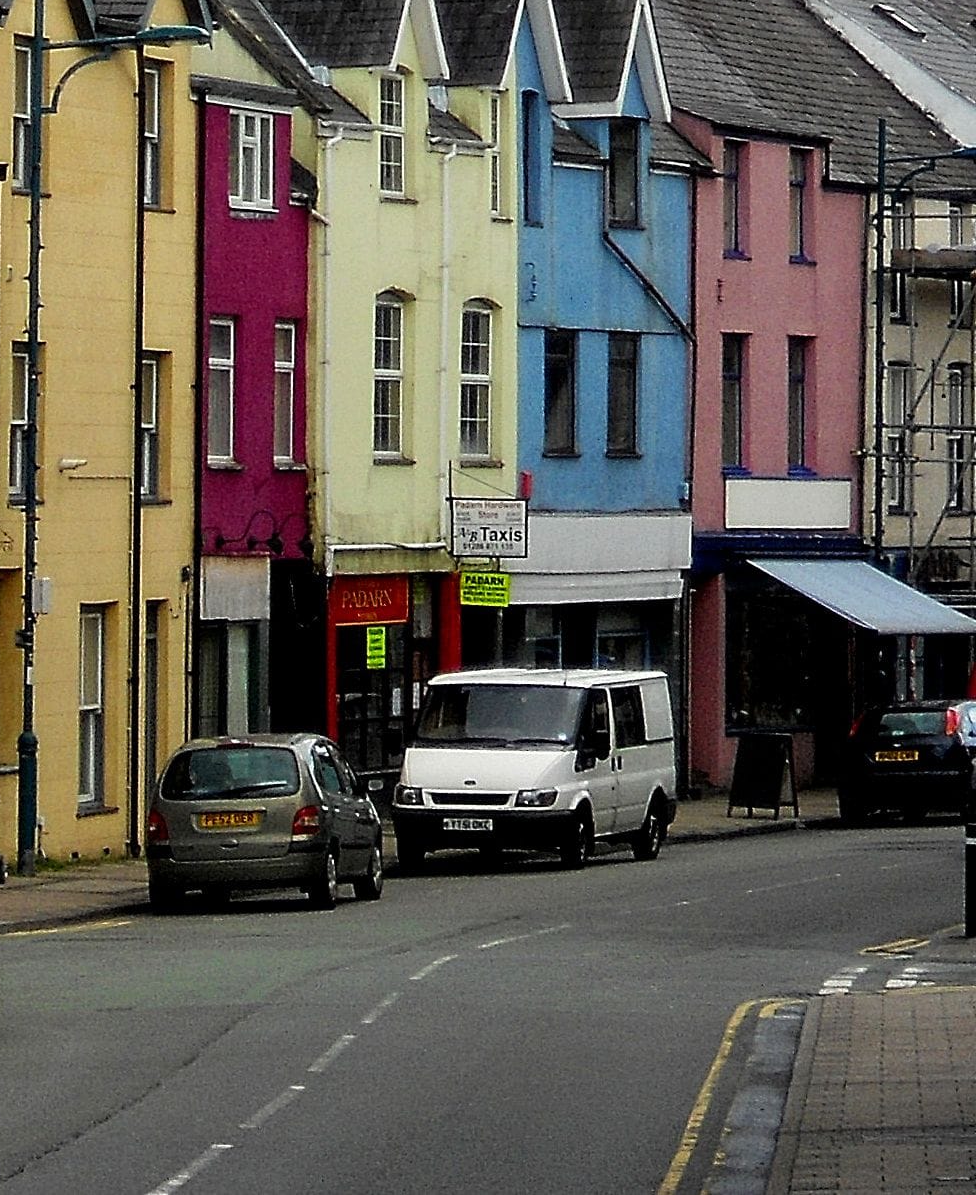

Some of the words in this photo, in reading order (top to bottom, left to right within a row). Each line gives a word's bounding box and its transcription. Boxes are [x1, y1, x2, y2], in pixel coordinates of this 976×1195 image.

[480, 527, 522, 542] Taxis
[465, 575, 504, 586] PADARN
[342, 589, 392, 608] PADARN
